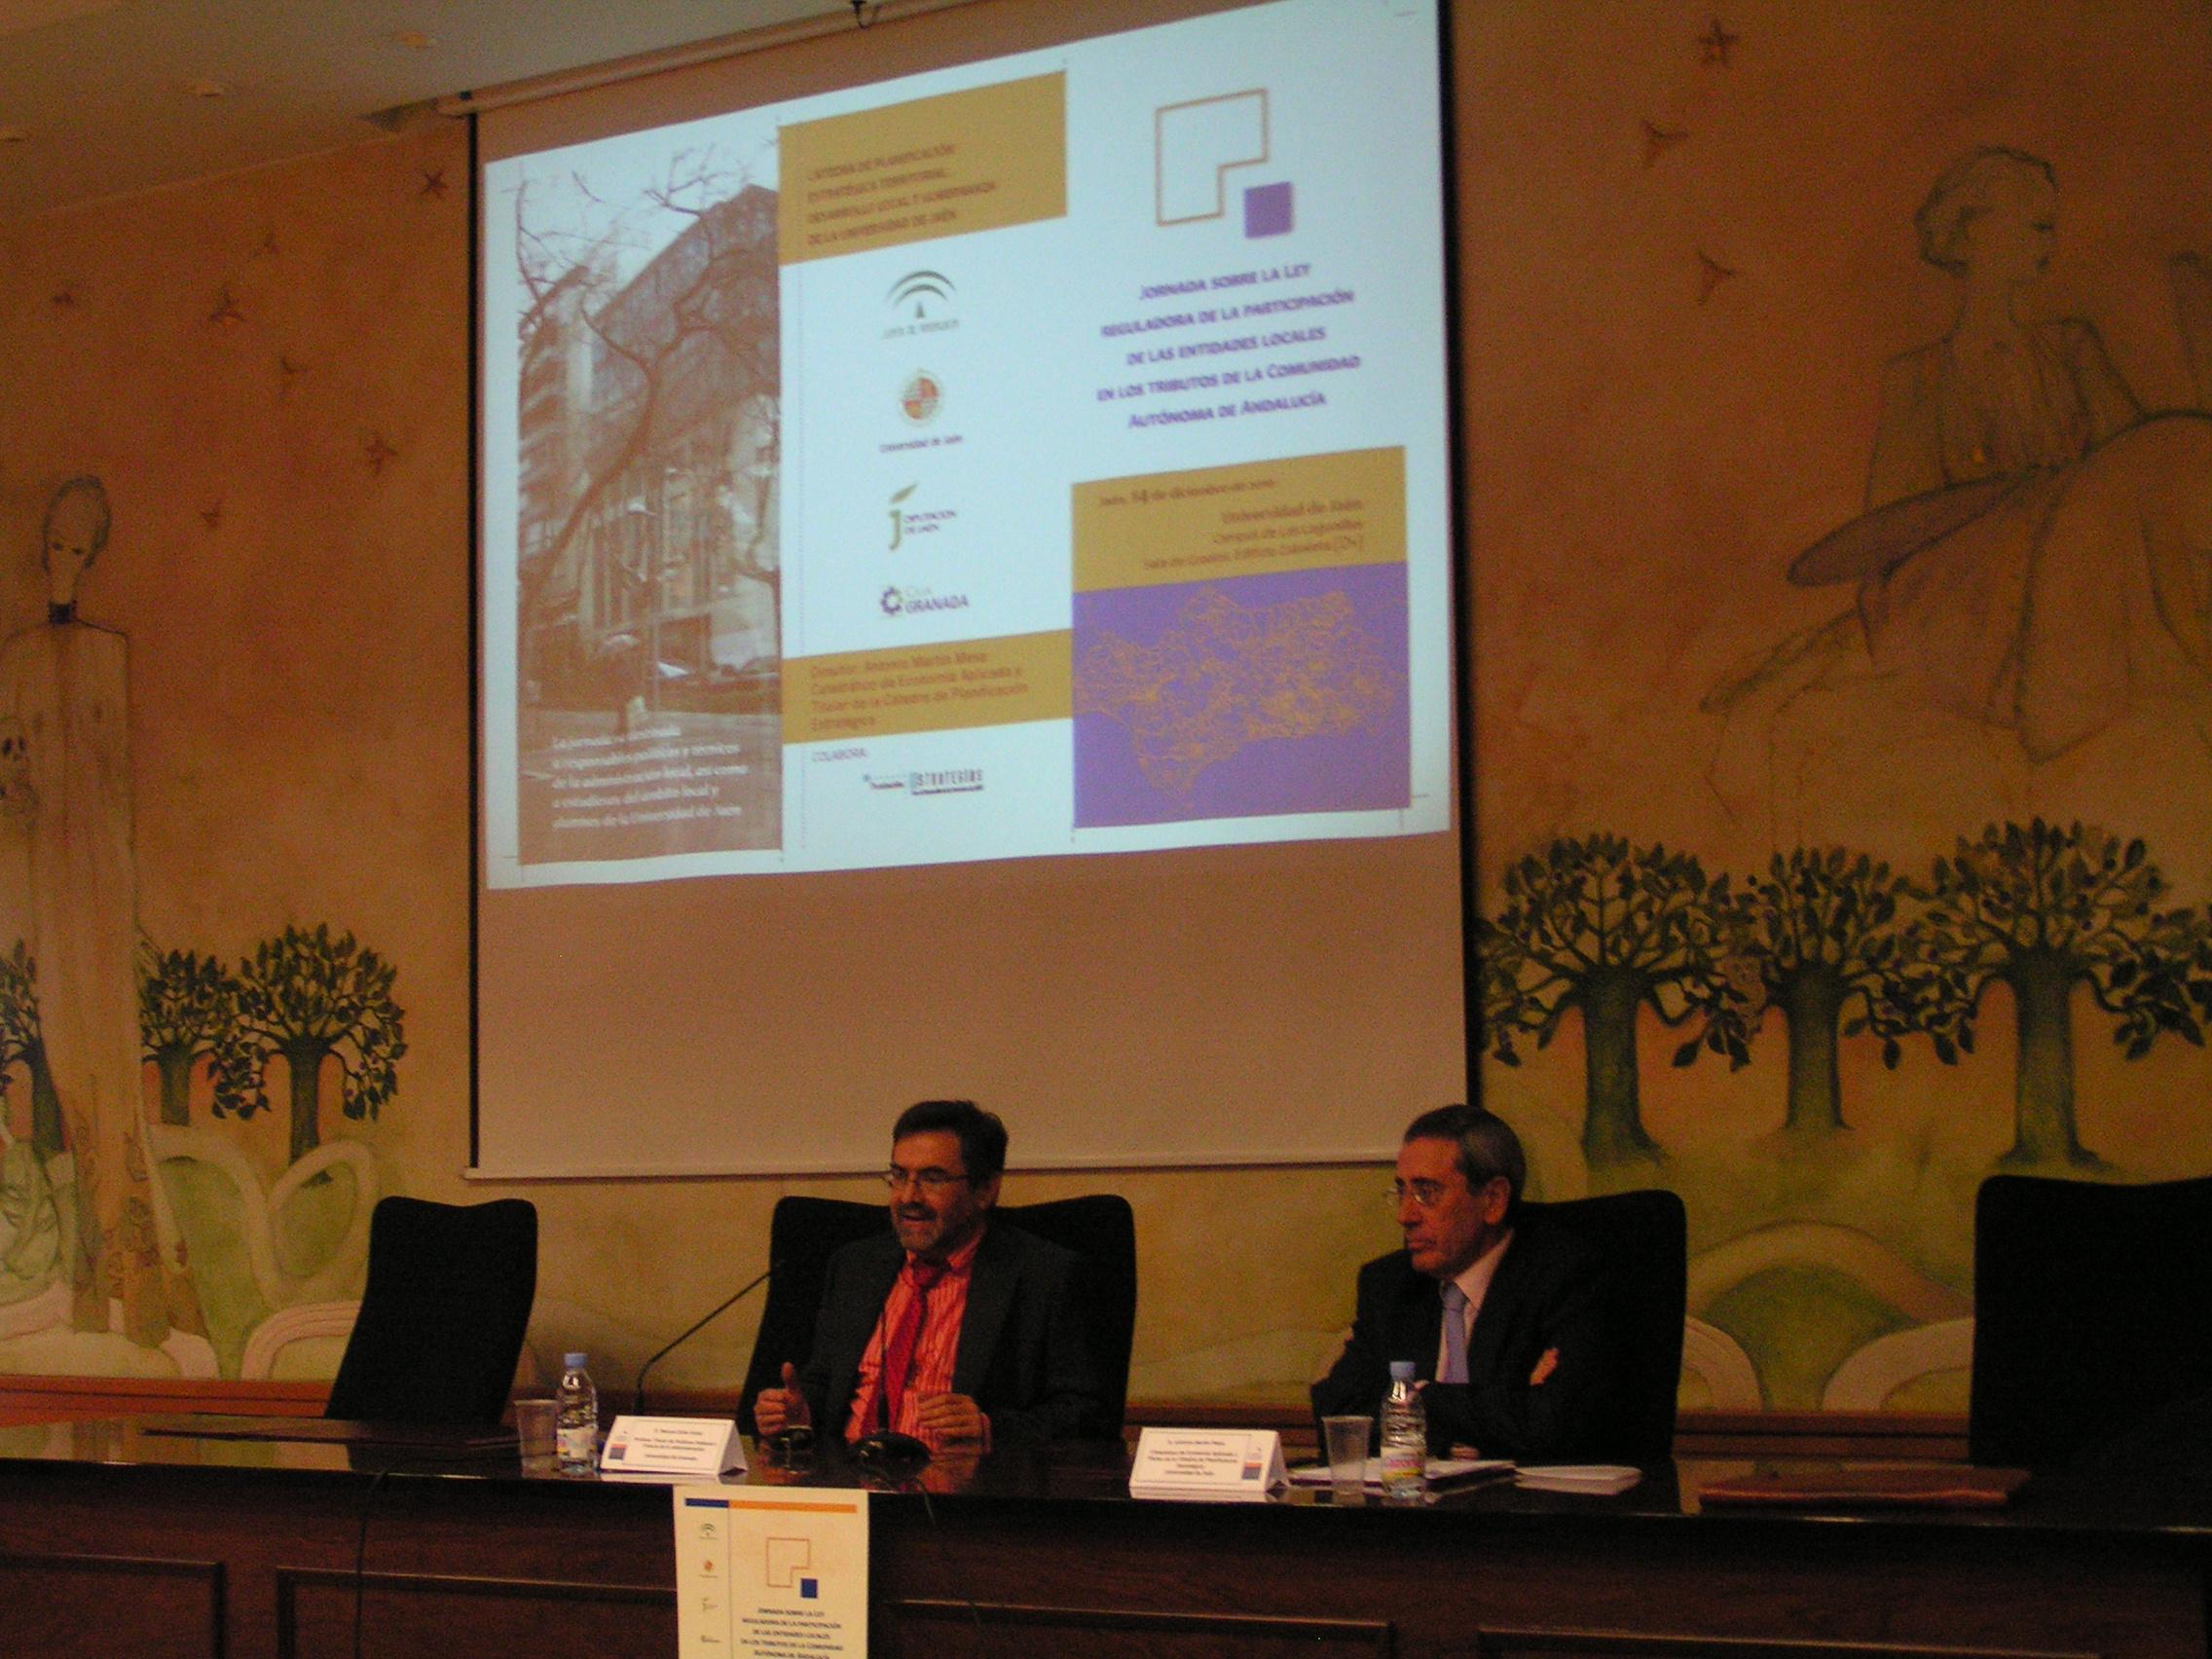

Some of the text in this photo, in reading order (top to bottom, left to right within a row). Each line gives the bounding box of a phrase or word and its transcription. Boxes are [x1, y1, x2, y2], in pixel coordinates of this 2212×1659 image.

[1139, 263, 1311, 300] JORNADA SOBRE LA LEY
[1101, 288, 1354, 337] REGULADORA DE LA PARTICIPACIÓN
[1126, 326, 1327, 366] DE LAS ENTIDADES LOCALES
[1097, 354, 1361, 401] EN LOS TRIBUTOS DE LA COMUNIDAD
[1218, 404, 1236, 419] DE
[1240, 390, 1326, 415] ANDALUCÍA
[905, 594, 969, 613] GRANADA
